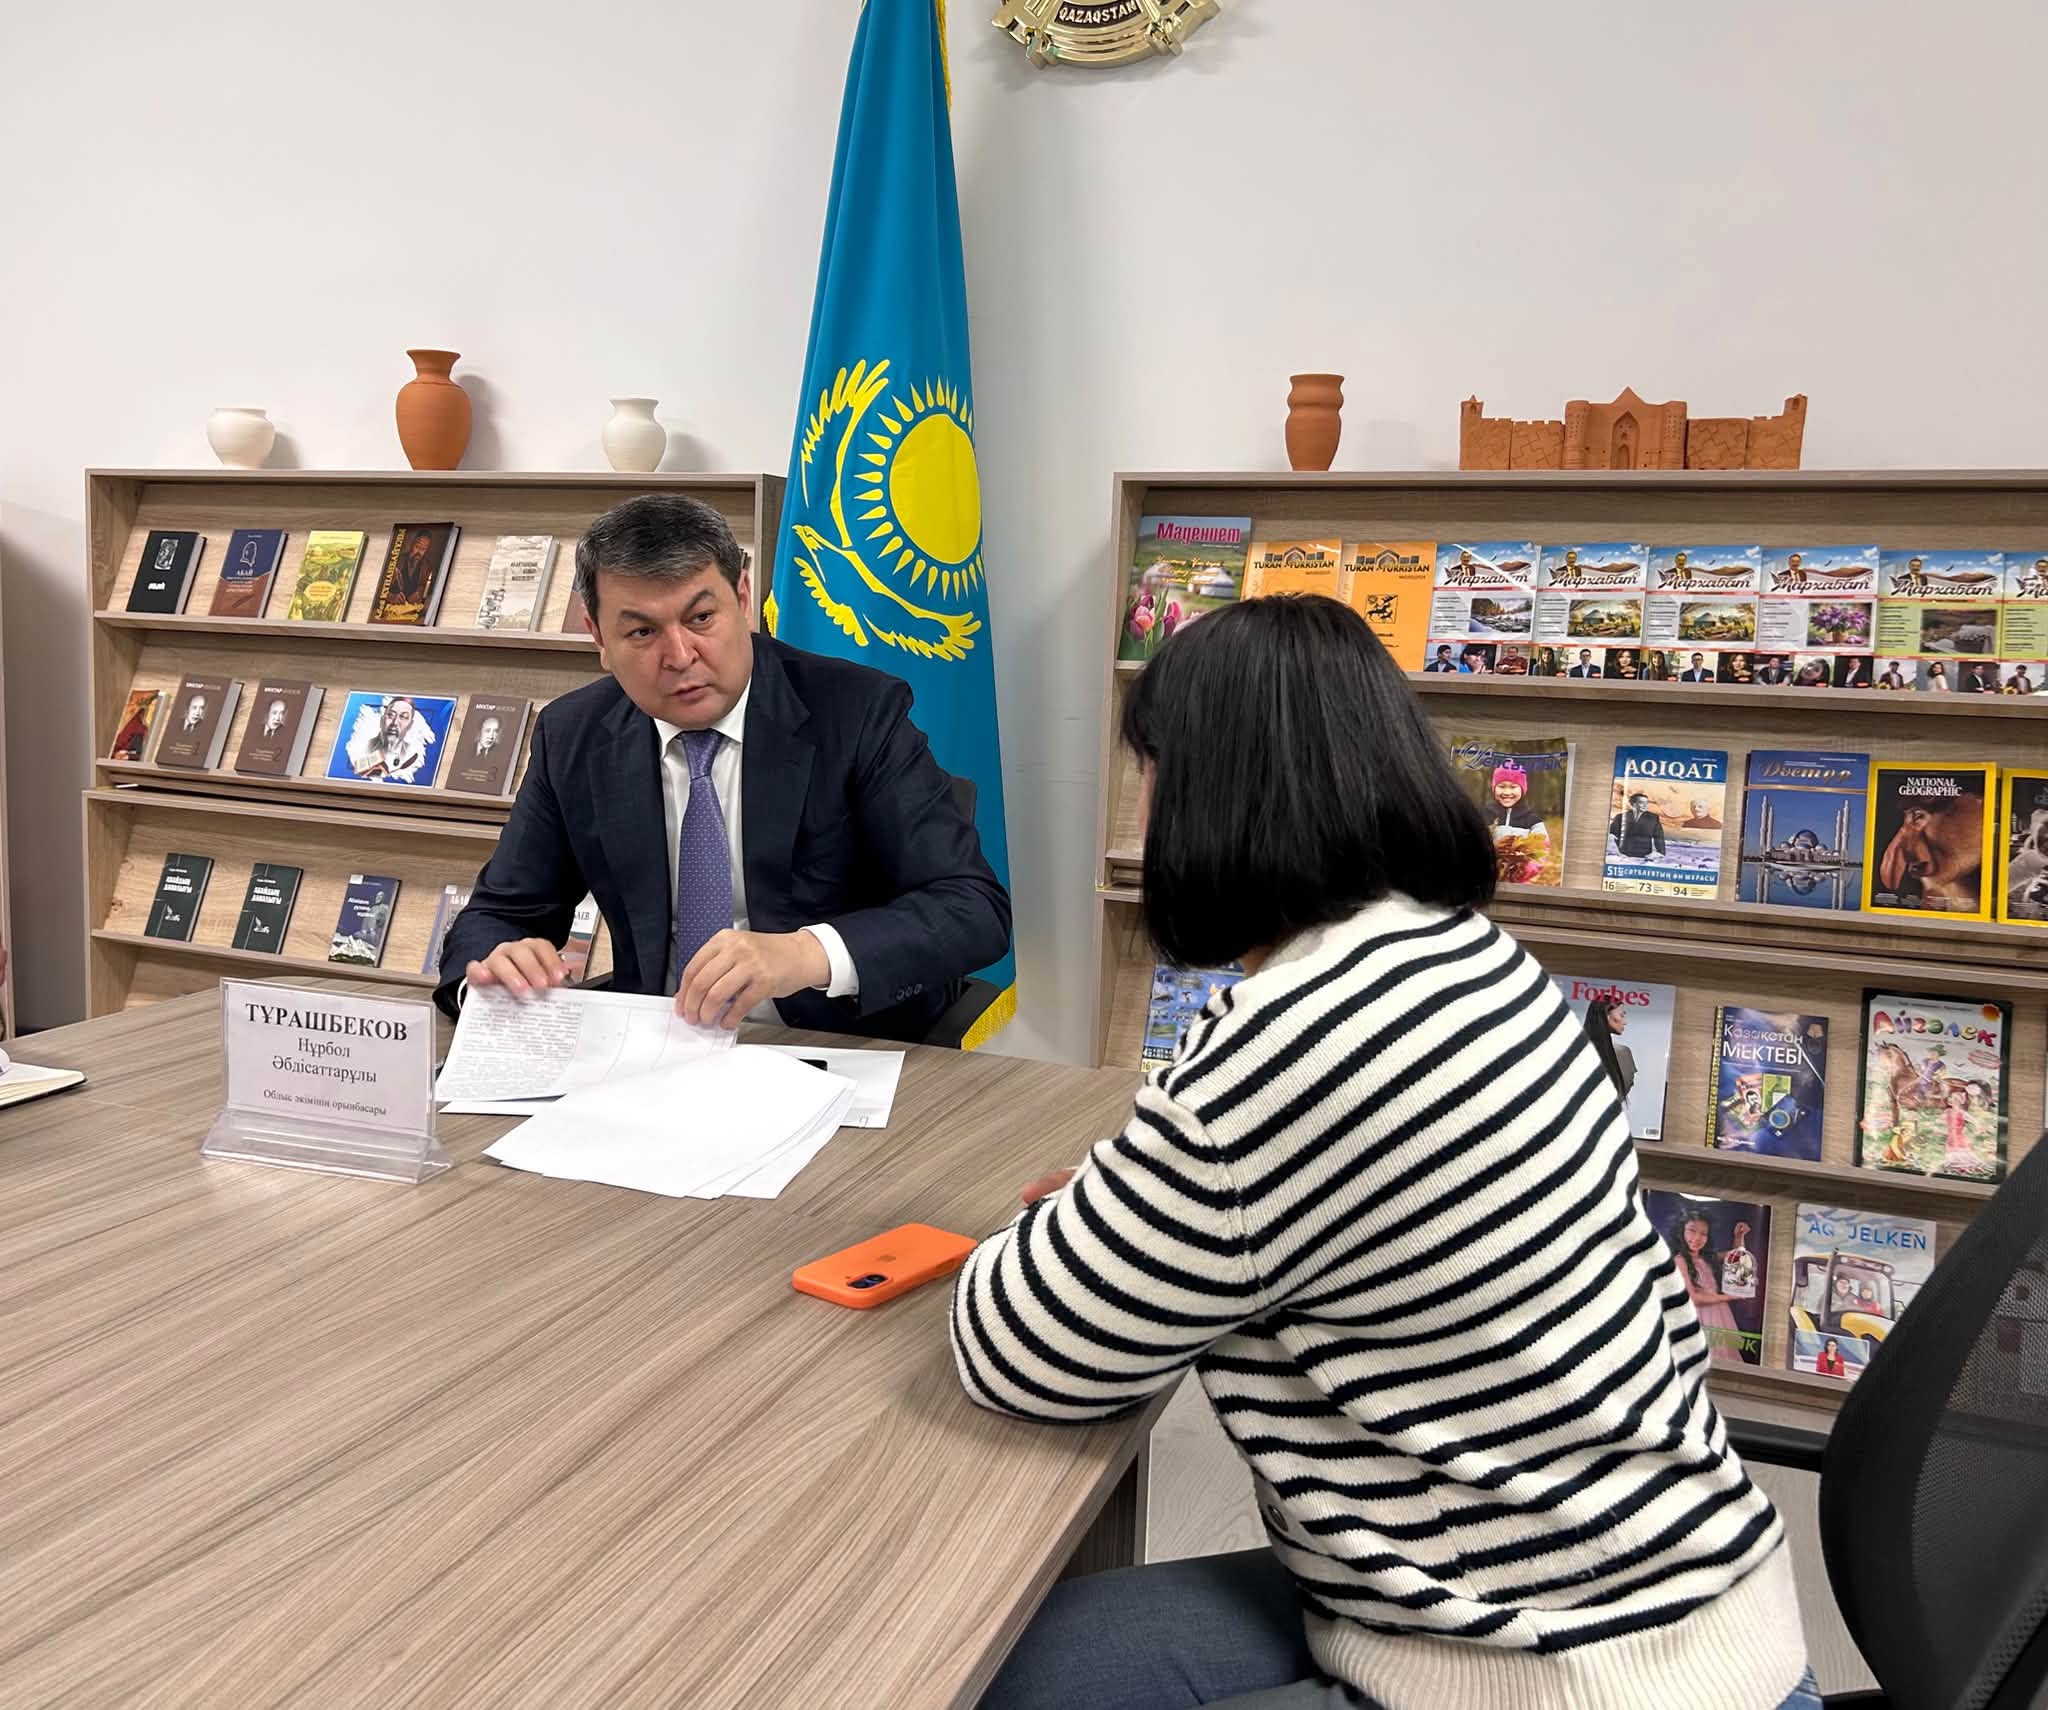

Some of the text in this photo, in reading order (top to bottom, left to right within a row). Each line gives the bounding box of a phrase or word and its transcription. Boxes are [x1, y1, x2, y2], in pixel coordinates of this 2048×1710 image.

[1058, 4, 1138, 25] QAZAQSTAN
[1627, 757, 1718, 780] AQIQAT
[1898, 785, 1962, 797] GEOGRAPHIC
[1906, 776, 1957, 788] NATIONAL
[1604, 880, 1615, 891] 16
[1639, 882, 1652, 893] 73
[1673, 886, 1688, 897] 94
[1571, 981, 1651, 1007] Forbes
[245, 1003, 408, 1041] ТҰРАШБЕКОВ
[298, 1037, 351, 1058] Нұрбол
[272, 1055, 378, 1084] Әбдісаттарұлы
[263, 1088, 293, 1102] Облыс
[332, 1100, 387, 1117] орынбасары
[1808, 1220, 1927, 1250] AQ JELKEN
